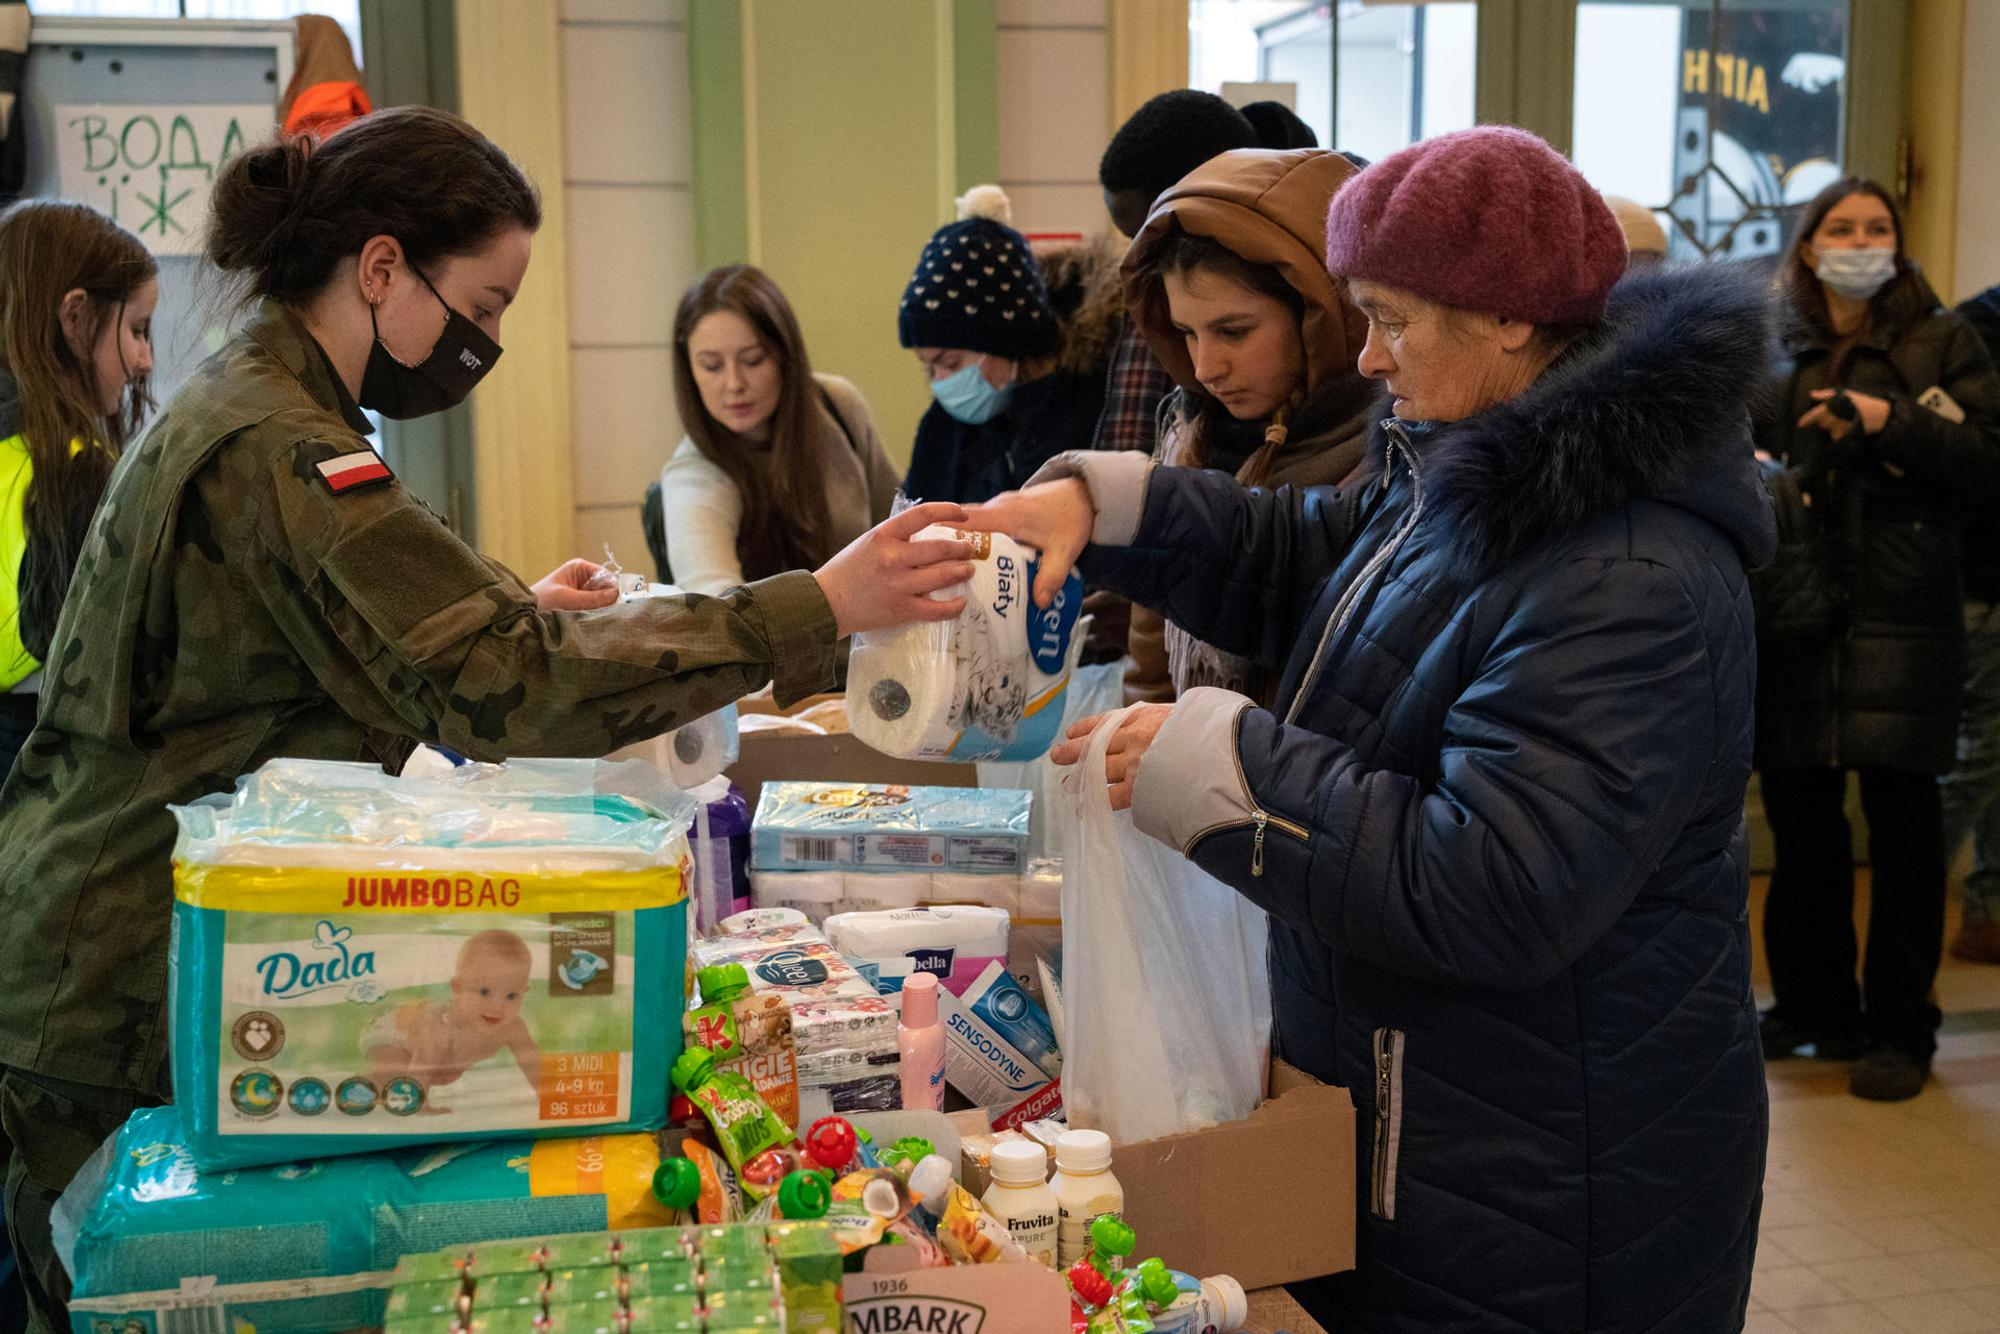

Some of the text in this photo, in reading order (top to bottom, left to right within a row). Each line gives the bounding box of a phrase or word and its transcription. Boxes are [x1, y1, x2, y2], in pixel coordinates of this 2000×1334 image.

[459, 347, 482, 370] WOT
[256, 941, 376, 996] Dada
[947, 1013, 1026, 1083] SENSODYNE
[558, 1056, 603, 1072] 3 MIDI
[556, 1077, 604, 1094] 4-9 kg
[550, 1101, 607, 1115] 96 sztuk
[1007, 1215, 1054, 1231] Fruvita
[872, 1280, 908, 1293] 1936
